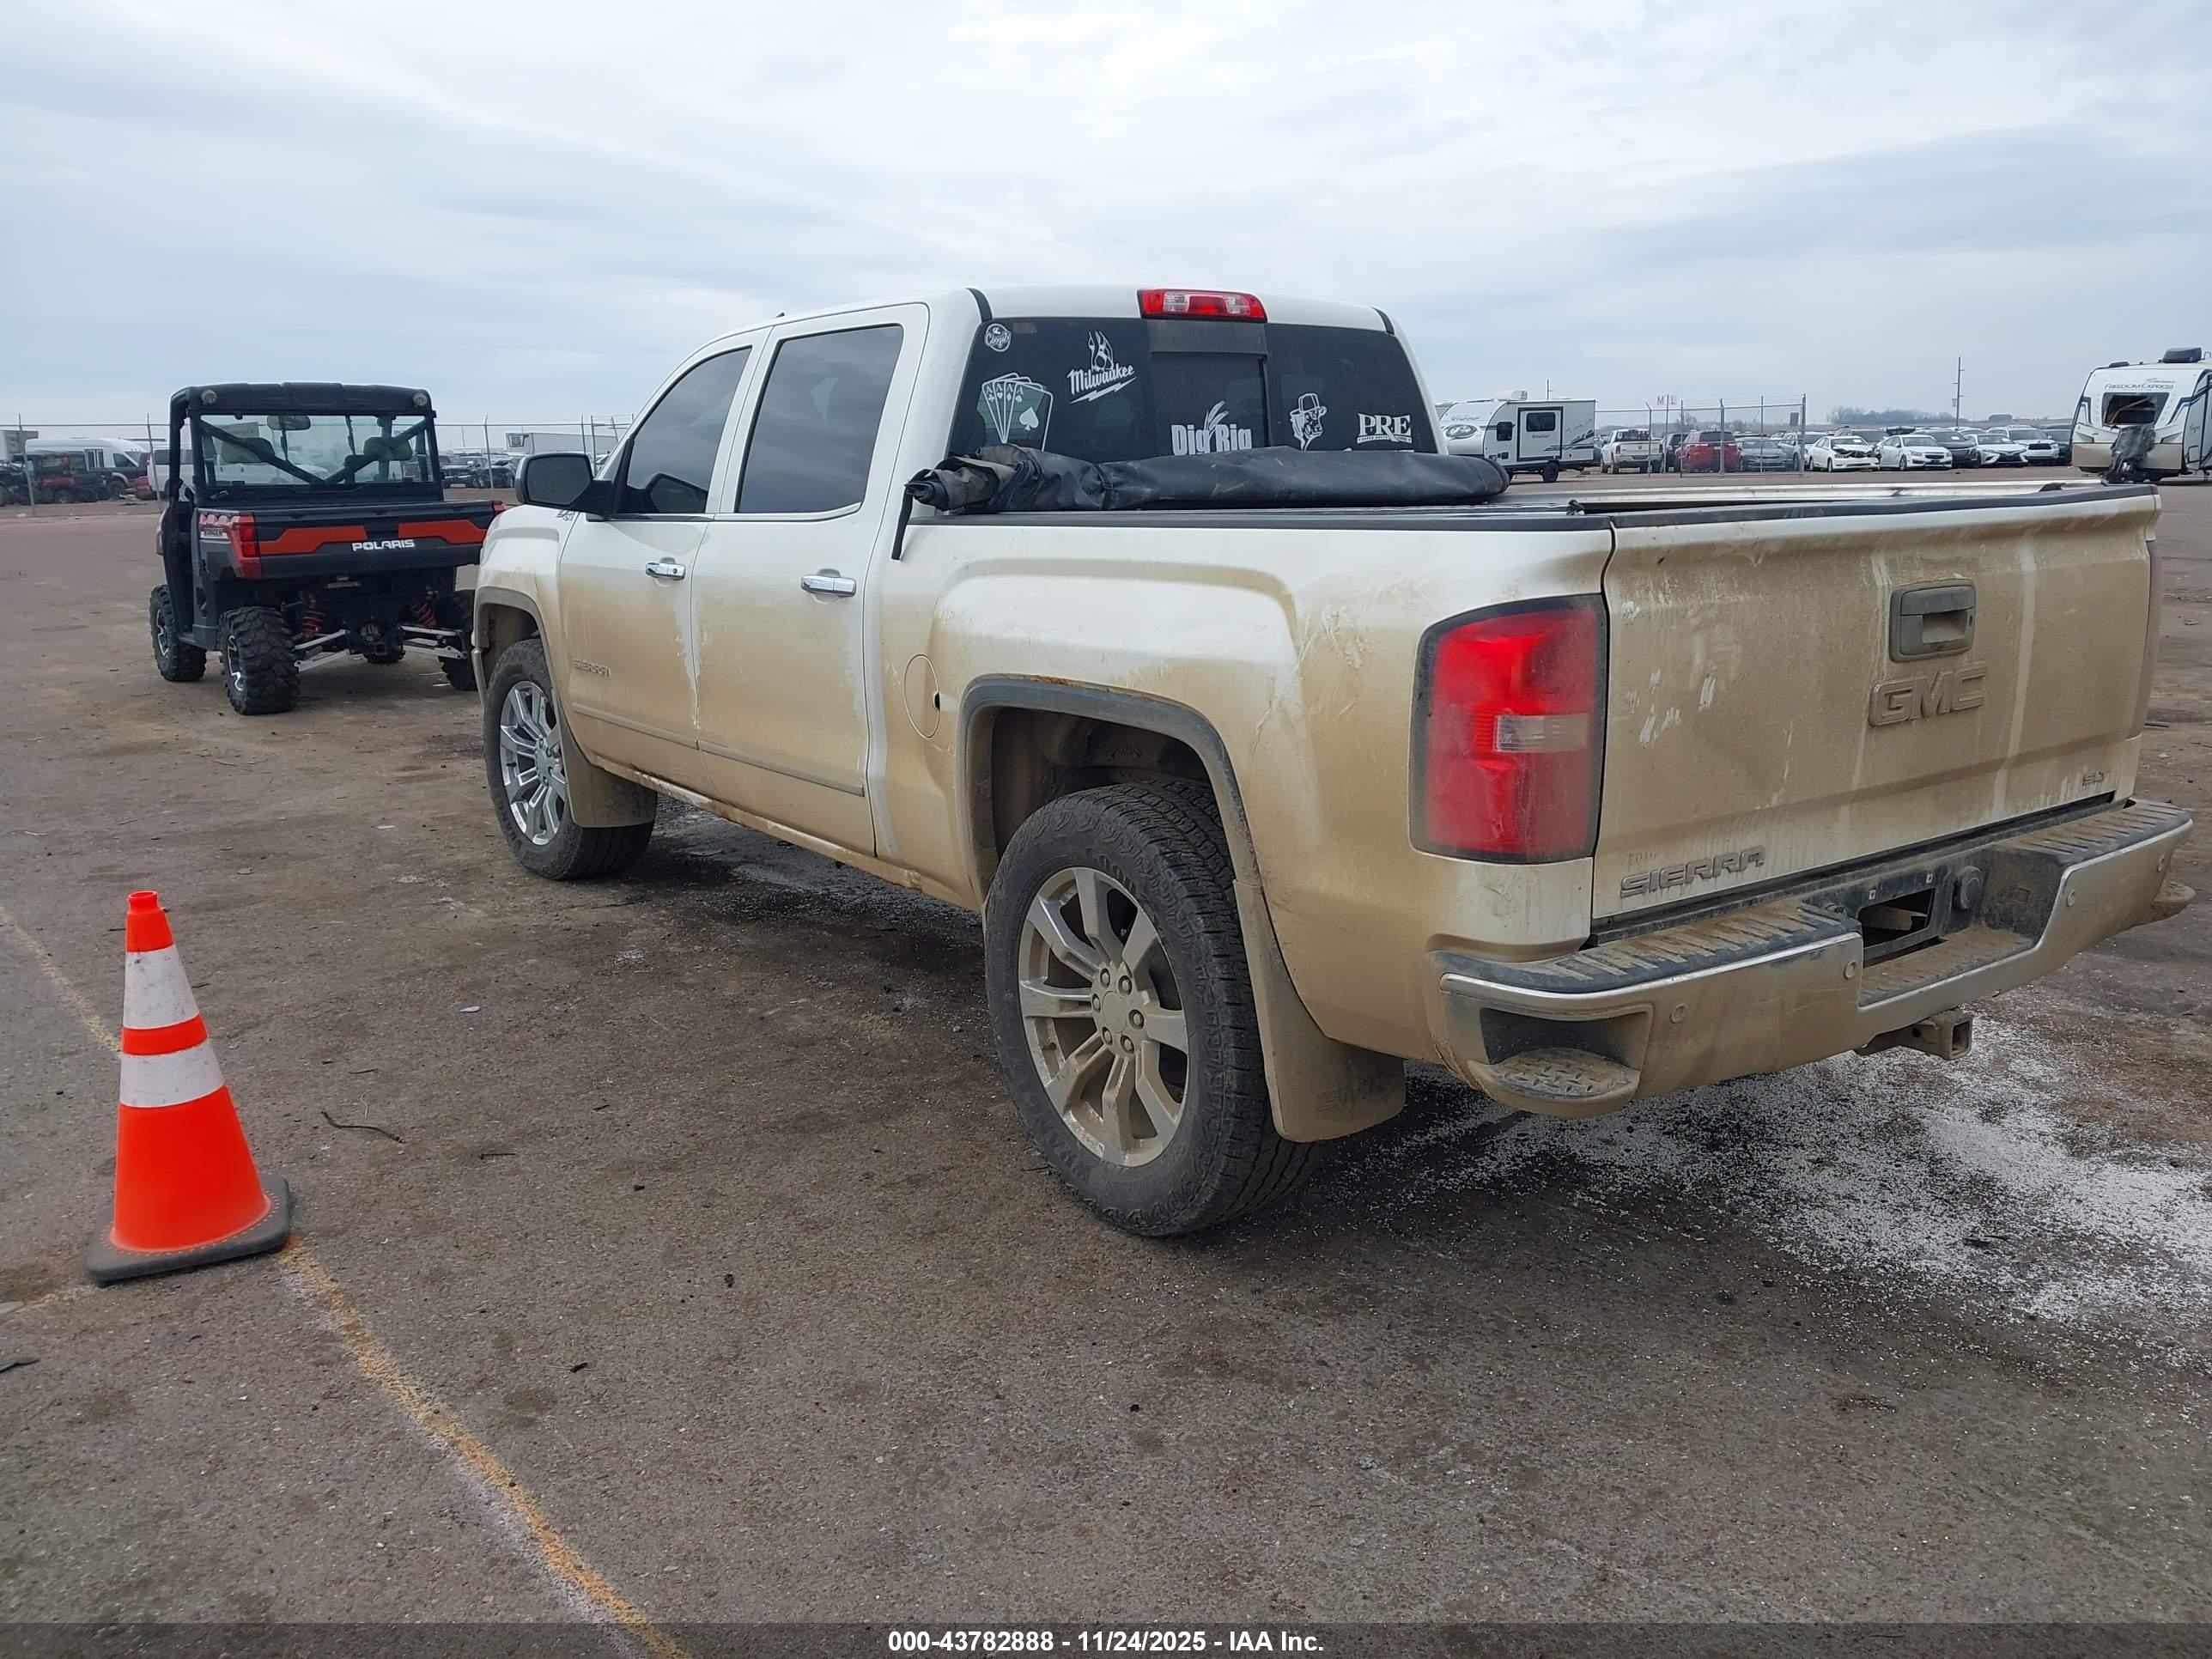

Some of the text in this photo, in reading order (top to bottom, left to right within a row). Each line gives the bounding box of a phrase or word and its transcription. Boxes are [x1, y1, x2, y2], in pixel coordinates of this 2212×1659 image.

[1066, 363, 1134, 395] Milwaukee
[1358, 413, 1412, 442] PRE
[351, 539, 416, 551] POLARIS
[1868, 667, 1988, 726] GMC
[1620, 846, 1765, 898] SIERRA
